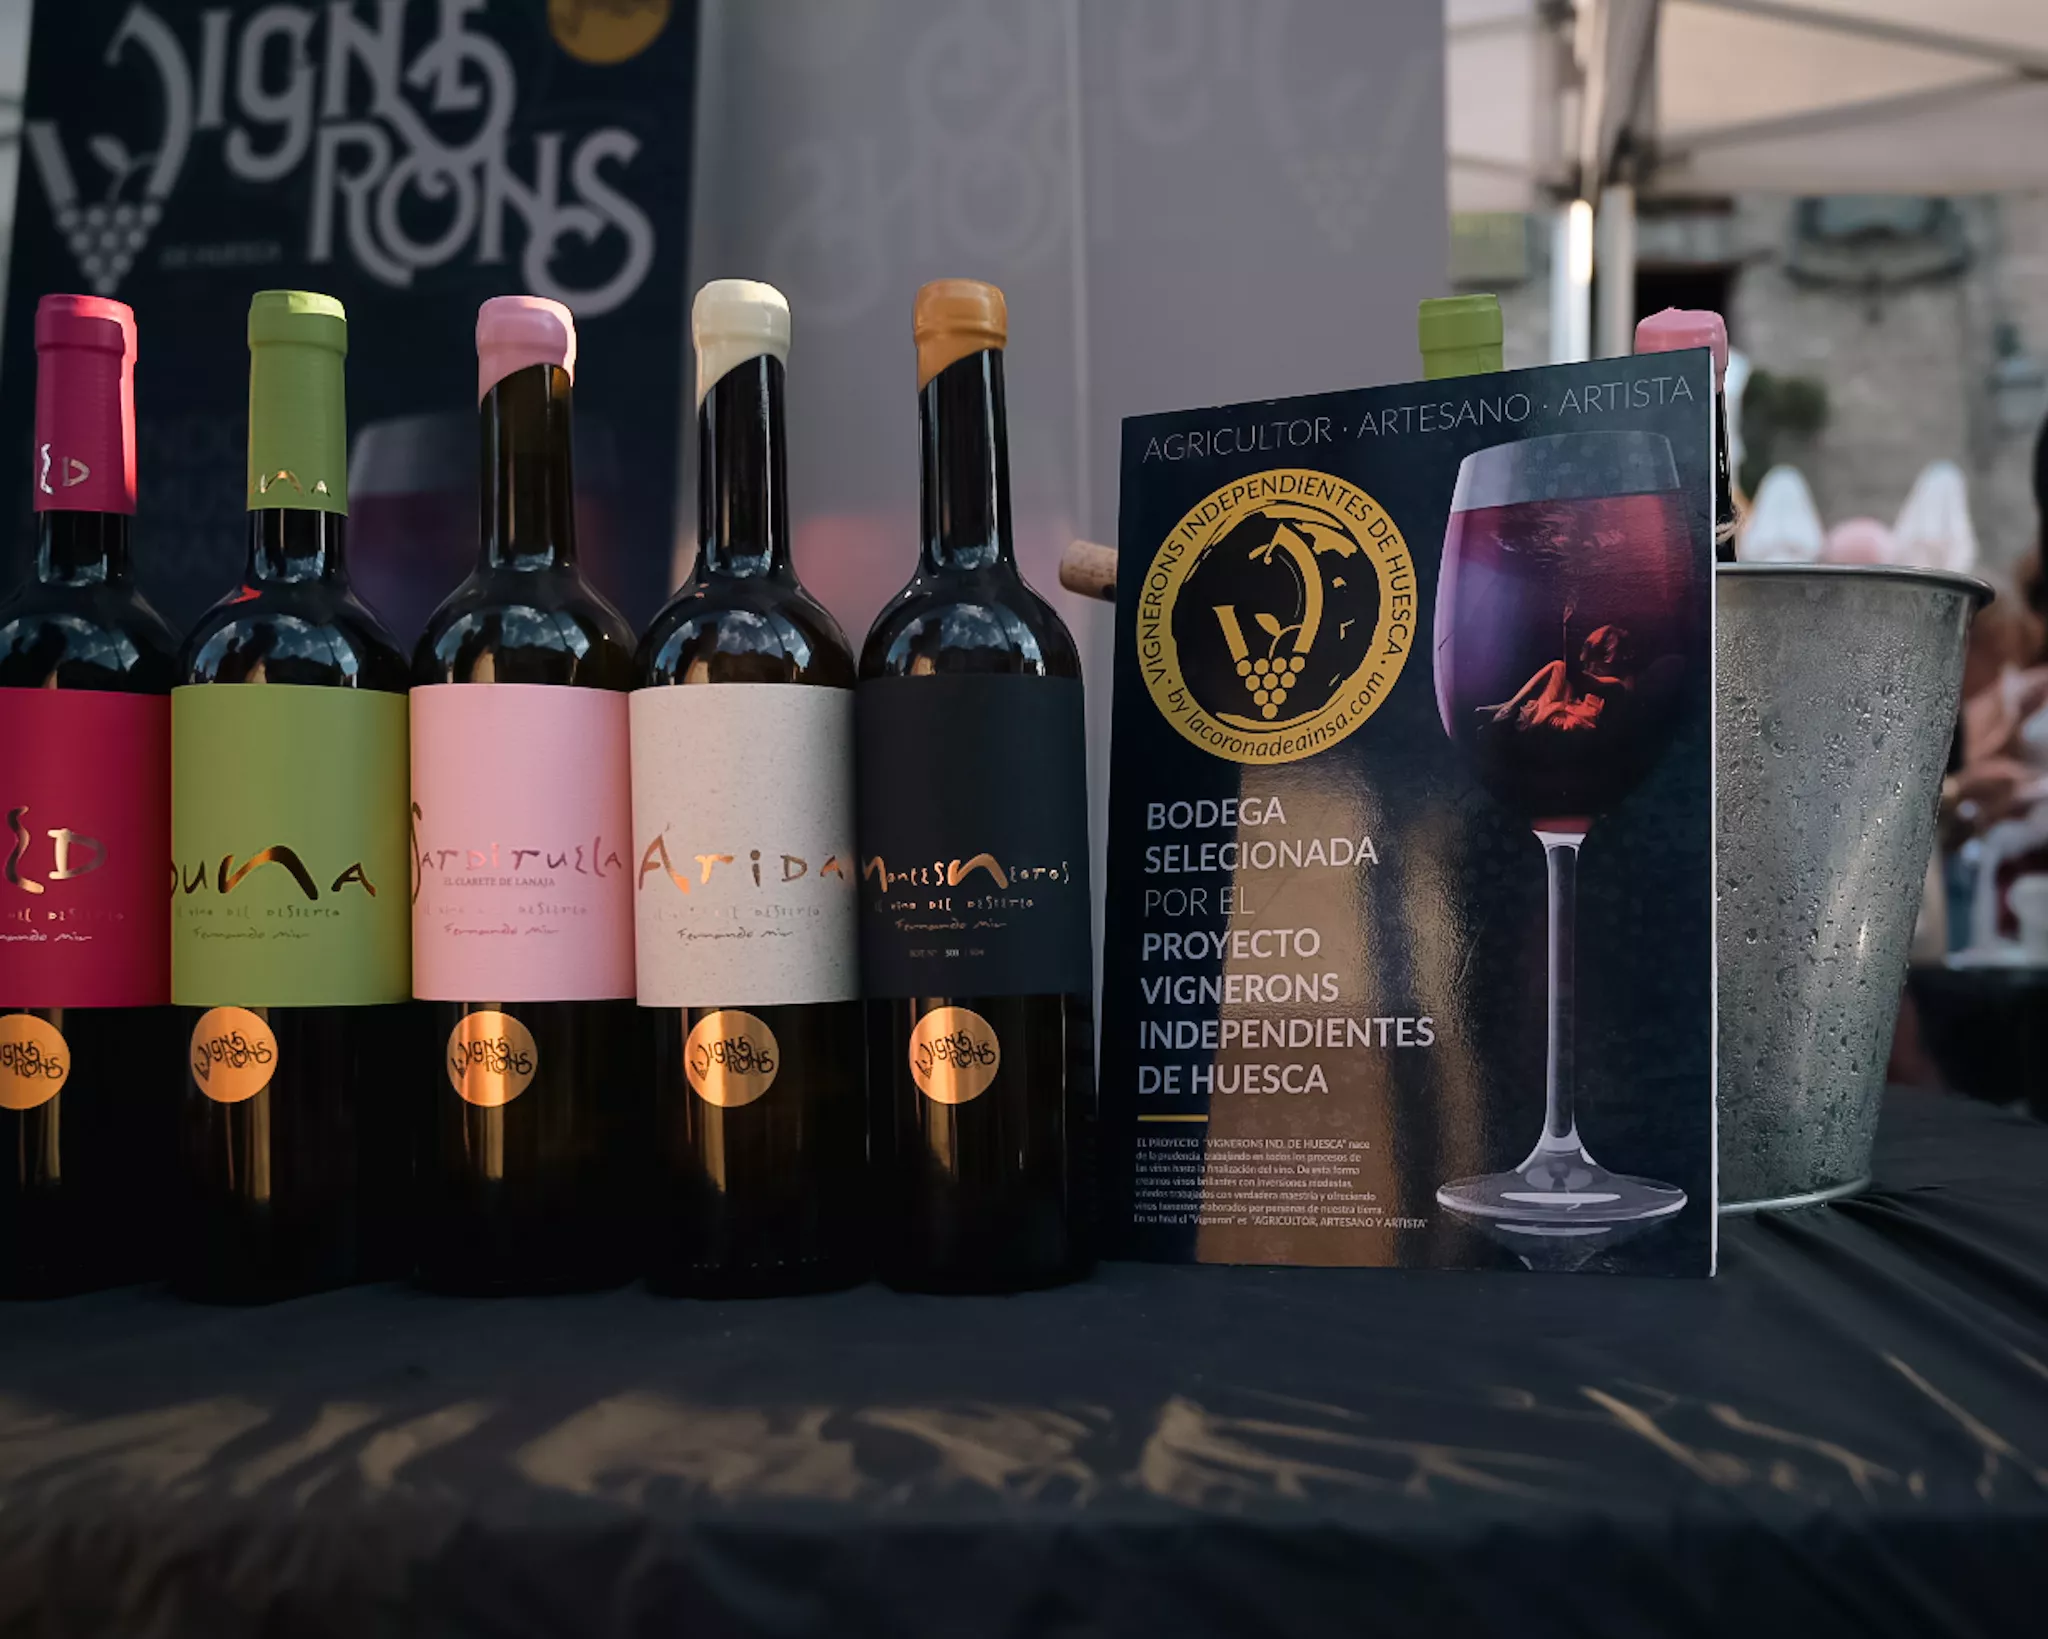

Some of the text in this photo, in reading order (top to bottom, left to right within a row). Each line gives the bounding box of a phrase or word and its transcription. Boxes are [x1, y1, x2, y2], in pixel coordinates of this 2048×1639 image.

[1142, 375, 1695, 464] AGRICULTOR ARTESANO ARTISTA
[1142, 474, 1412, 685] VIGNERONS INDEPENDIENTES DE HUESCA
[1167, 670, 1385, 758] by lacoronadeainsa.com
[1147, 796, 1287, 831] BODEGA
[1144, 835, 1379, 874] SELECIONADA
[456, 877, 497, 887] CLARETE
[499, 877, 513, 887] DE
[1144, 886, 1256, 918] POR EL
[1142, 927, 1320, 961] PROYECTO
[1140, 972, 1340, 1005] VIGNERONS
[1139, 1016, 1436, 1050] INDEPENDIENTES
[1138, 1063, 1329, 1095] DE HUESCA
[1136, 1138, 1147, 1147] EL
[1148, 1138, 1200, 1147] PROYECTO
[1265, 1139, 1285, 1149] IND.
[1287, 1139, 1302, 1149] DE
[1304, 1139, 1346, 1149] HUESCA"
[1348, 1140, 1370, 1149] nace
[1204, 1152, 1251, 1162] trabajando
[1307, 1153, 1347, 1163] procesos
[1349, 1153, 1361, 1162] de
[1238, 1178, 1254, 1187] con
[1248, 1204, 1263, 1213] por
[1307, 1203, 1319, 1213] de
[1320, 1217, 1373, 1227] ARTESANO
[1384, 1218, 1429, 1229] ARTISTA"
